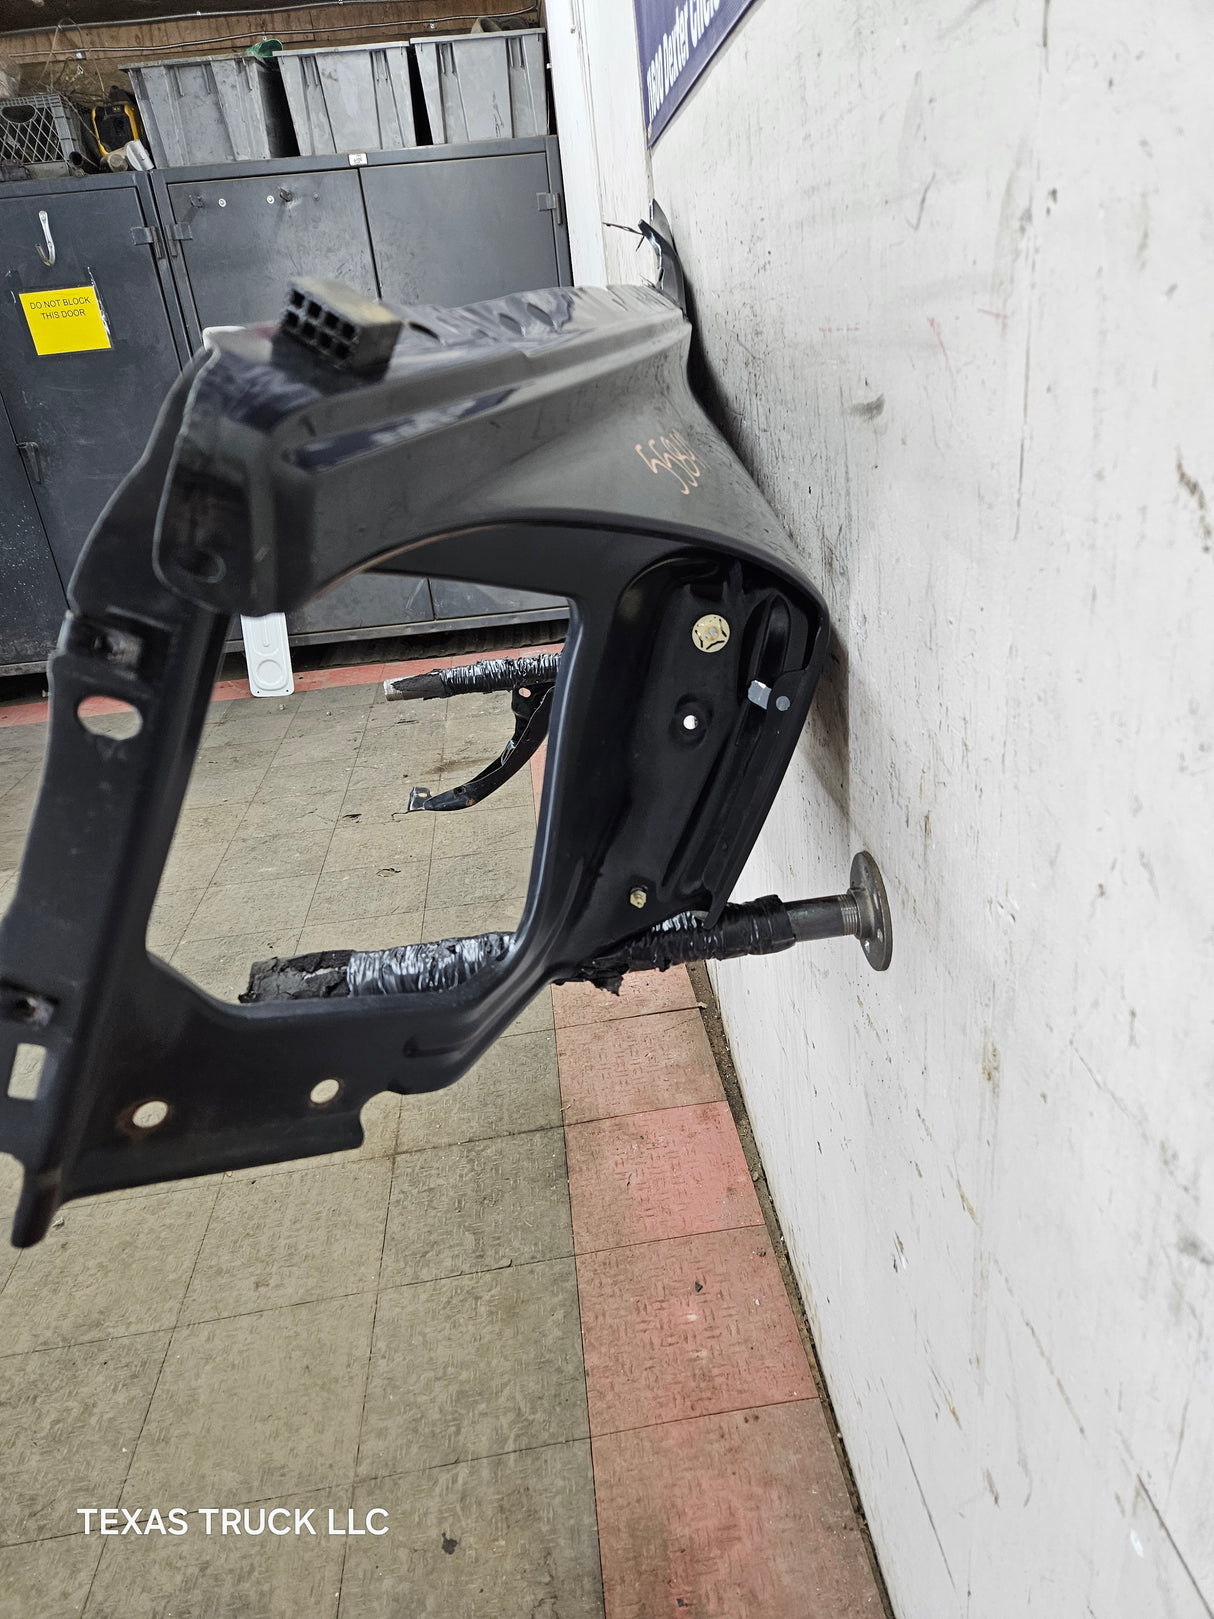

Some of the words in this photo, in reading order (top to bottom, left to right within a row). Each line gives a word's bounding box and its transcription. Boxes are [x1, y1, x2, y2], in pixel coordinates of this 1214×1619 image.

[663, 0, 689, 96] Dexter
[690, 0, 720, 48] Circ
[29, 302, 42, 310] DO
[43, 300, 60, 308] NOT
[62, 296, 91, 307] BLOCK
[41, 311, 60, 320] THIS
[61, 309, 86, 318] DOOR
